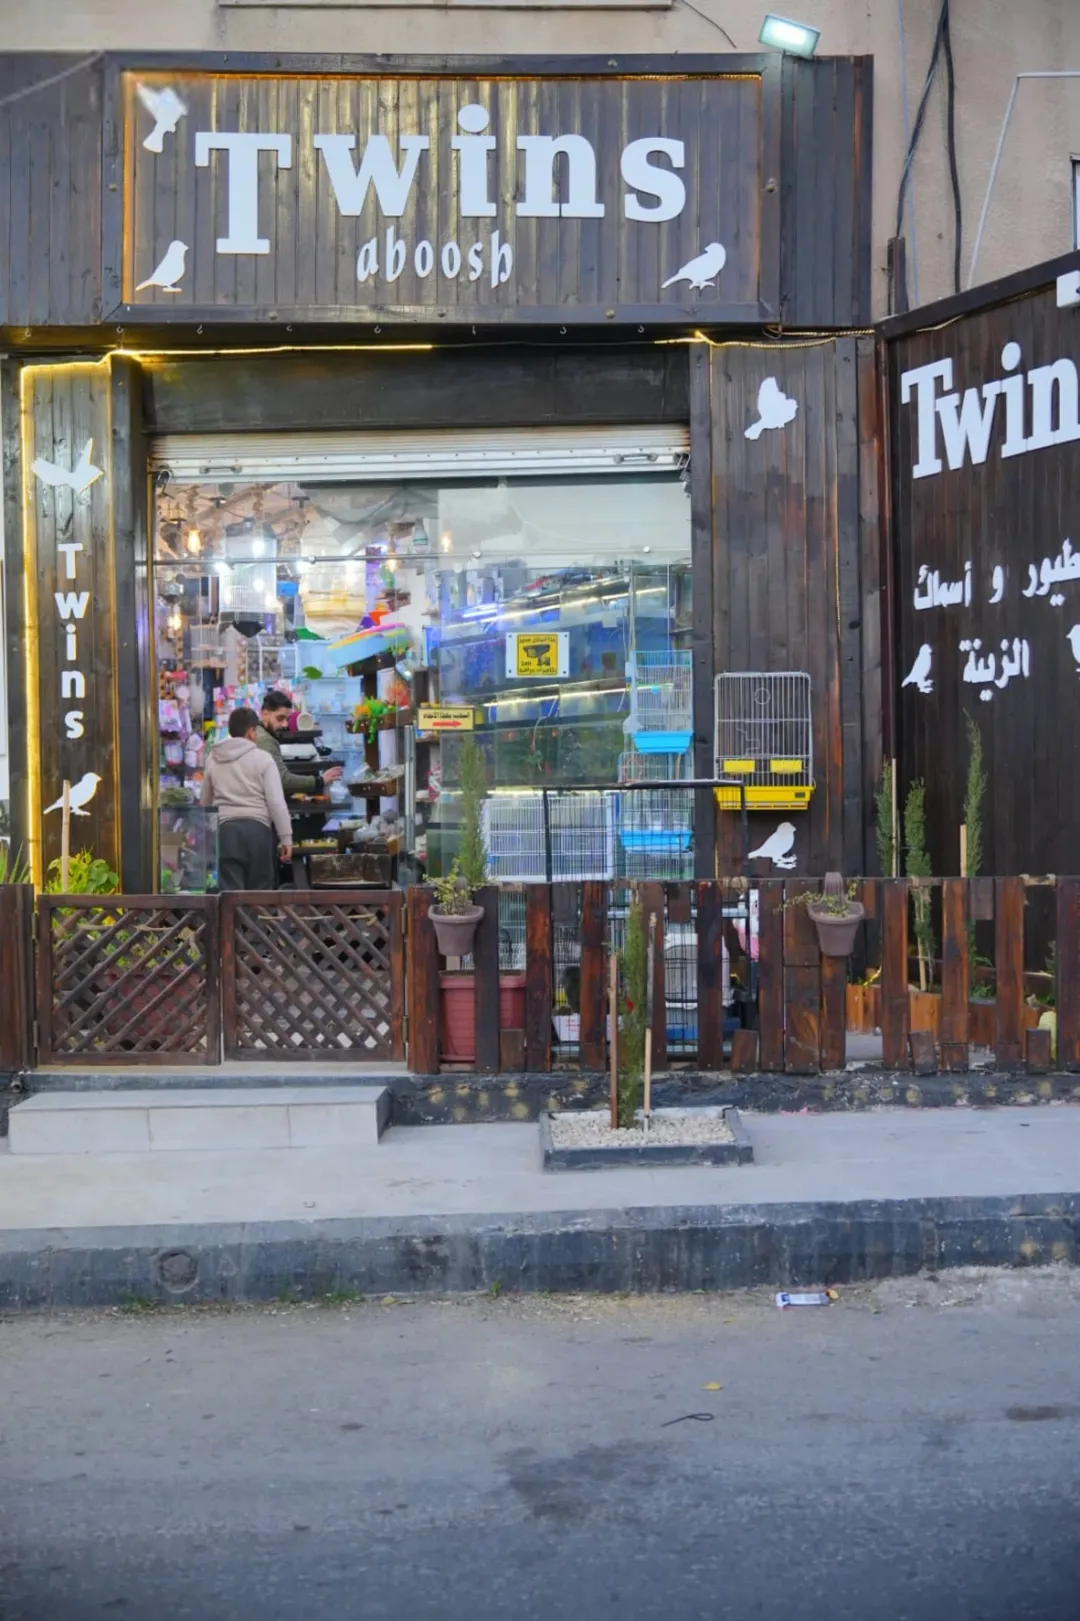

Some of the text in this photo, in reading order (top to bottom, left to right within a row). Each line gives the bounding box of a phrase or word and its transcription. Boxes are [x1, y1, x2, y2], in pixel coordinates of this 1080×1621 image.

[195, 103, 686, 254] Twins
[913, 538, 1080, 610] طيور و أسماك
[54, 542, 90, 740] Twins
[958, 637, 1030, 701] الزينة
